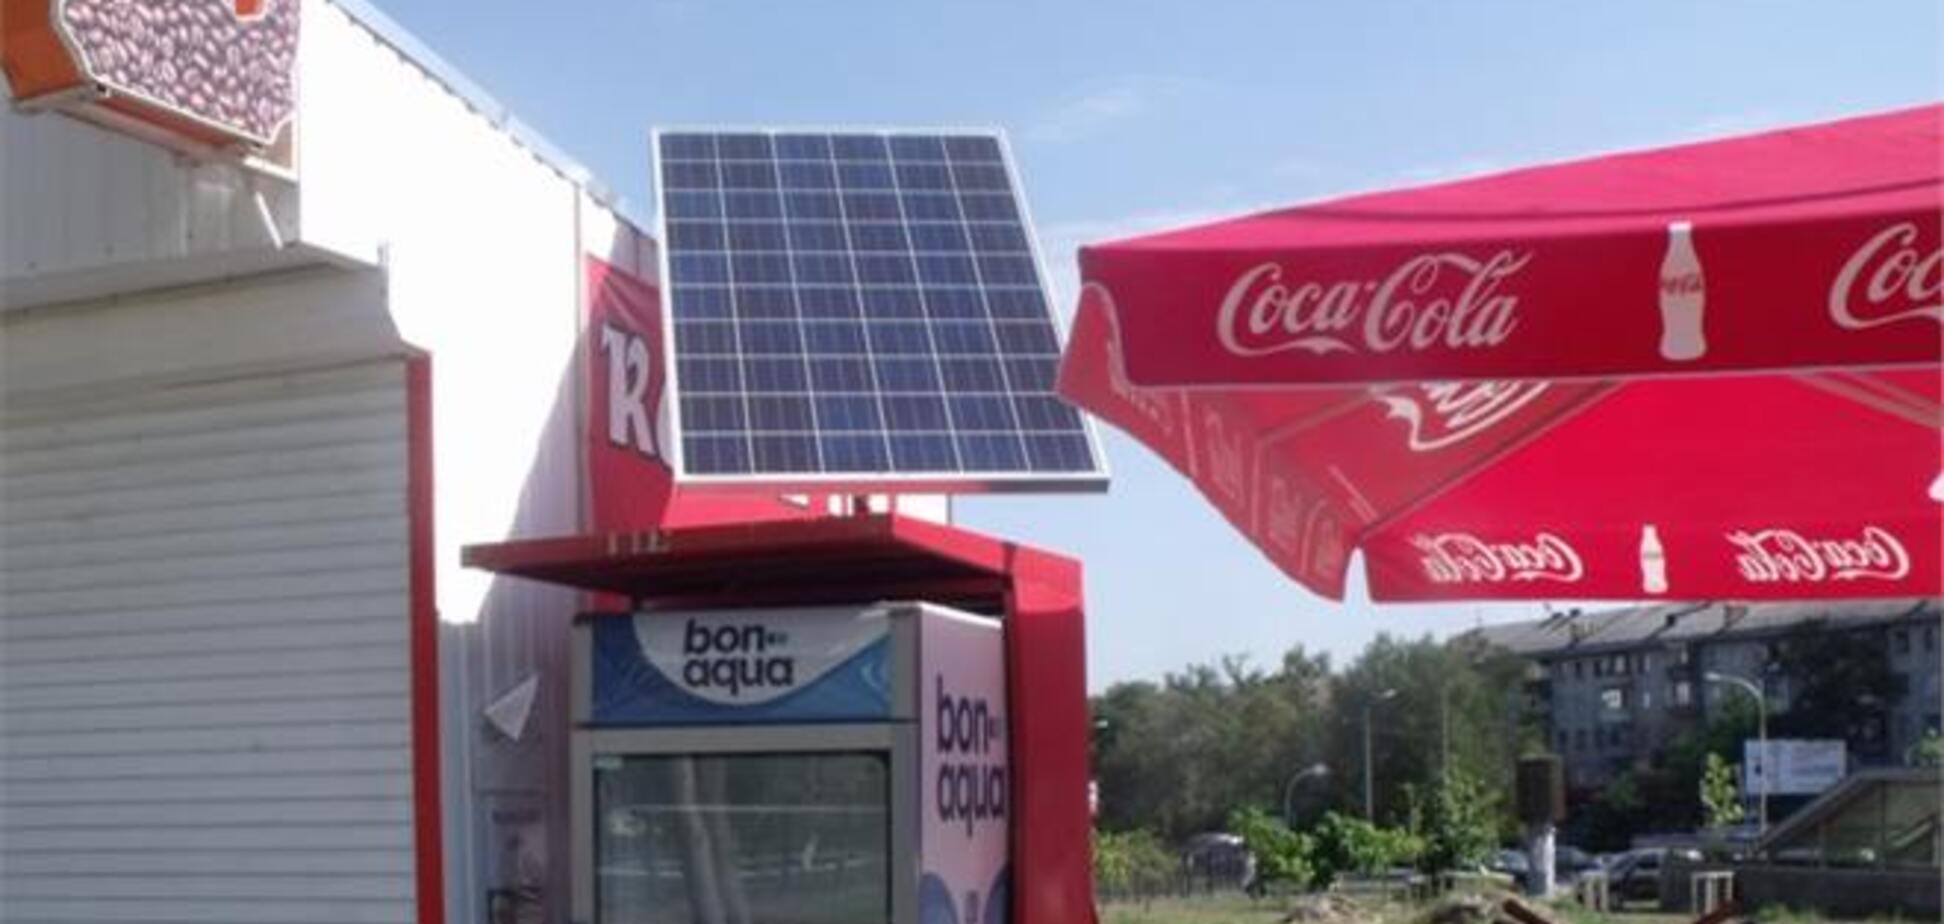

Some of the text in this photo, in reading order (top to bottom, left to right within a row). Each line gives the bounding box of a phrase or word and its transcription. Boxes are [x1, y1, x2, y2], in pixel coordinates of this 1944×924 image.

[1217, 250, 1533, 357] Coca-Cola
[683, 657, 794, 696] aqua
[937, 763, 1005, 838] aqua
